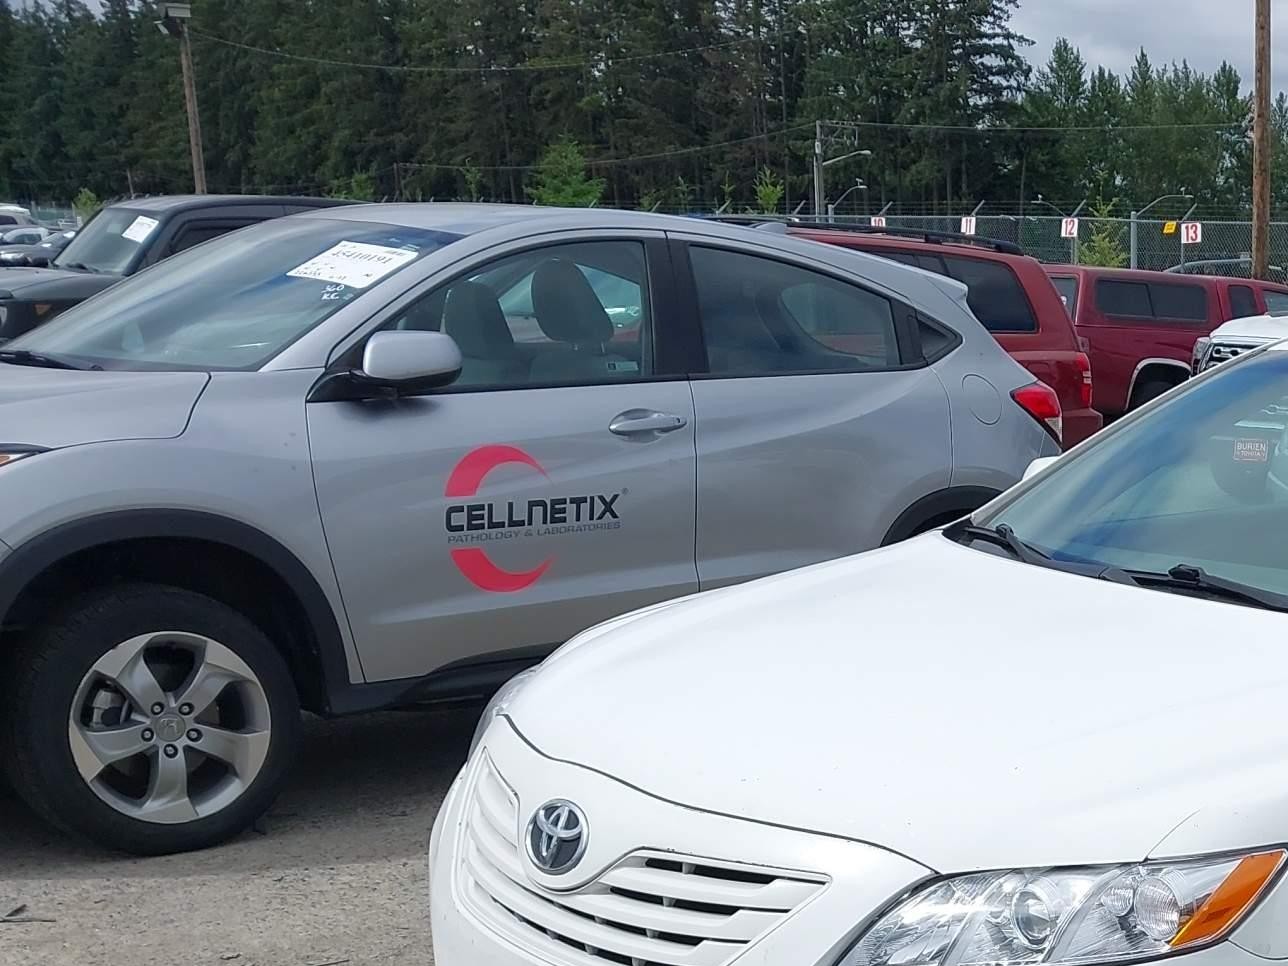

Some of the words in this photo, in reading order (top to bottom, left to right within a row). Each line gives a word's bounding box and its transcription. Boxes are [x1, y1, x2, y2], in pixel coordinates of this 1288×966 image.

[1065, 219, 1075, 235] 12
[1184, 223, 1198, 242] 13
[445, 494, 620, 533] CELLNETIX
[447, 529, 520, 544] PATHOLOGY
[524, 527, 534, 537] &
[537, 521, 621, 536] LABORATORIES
